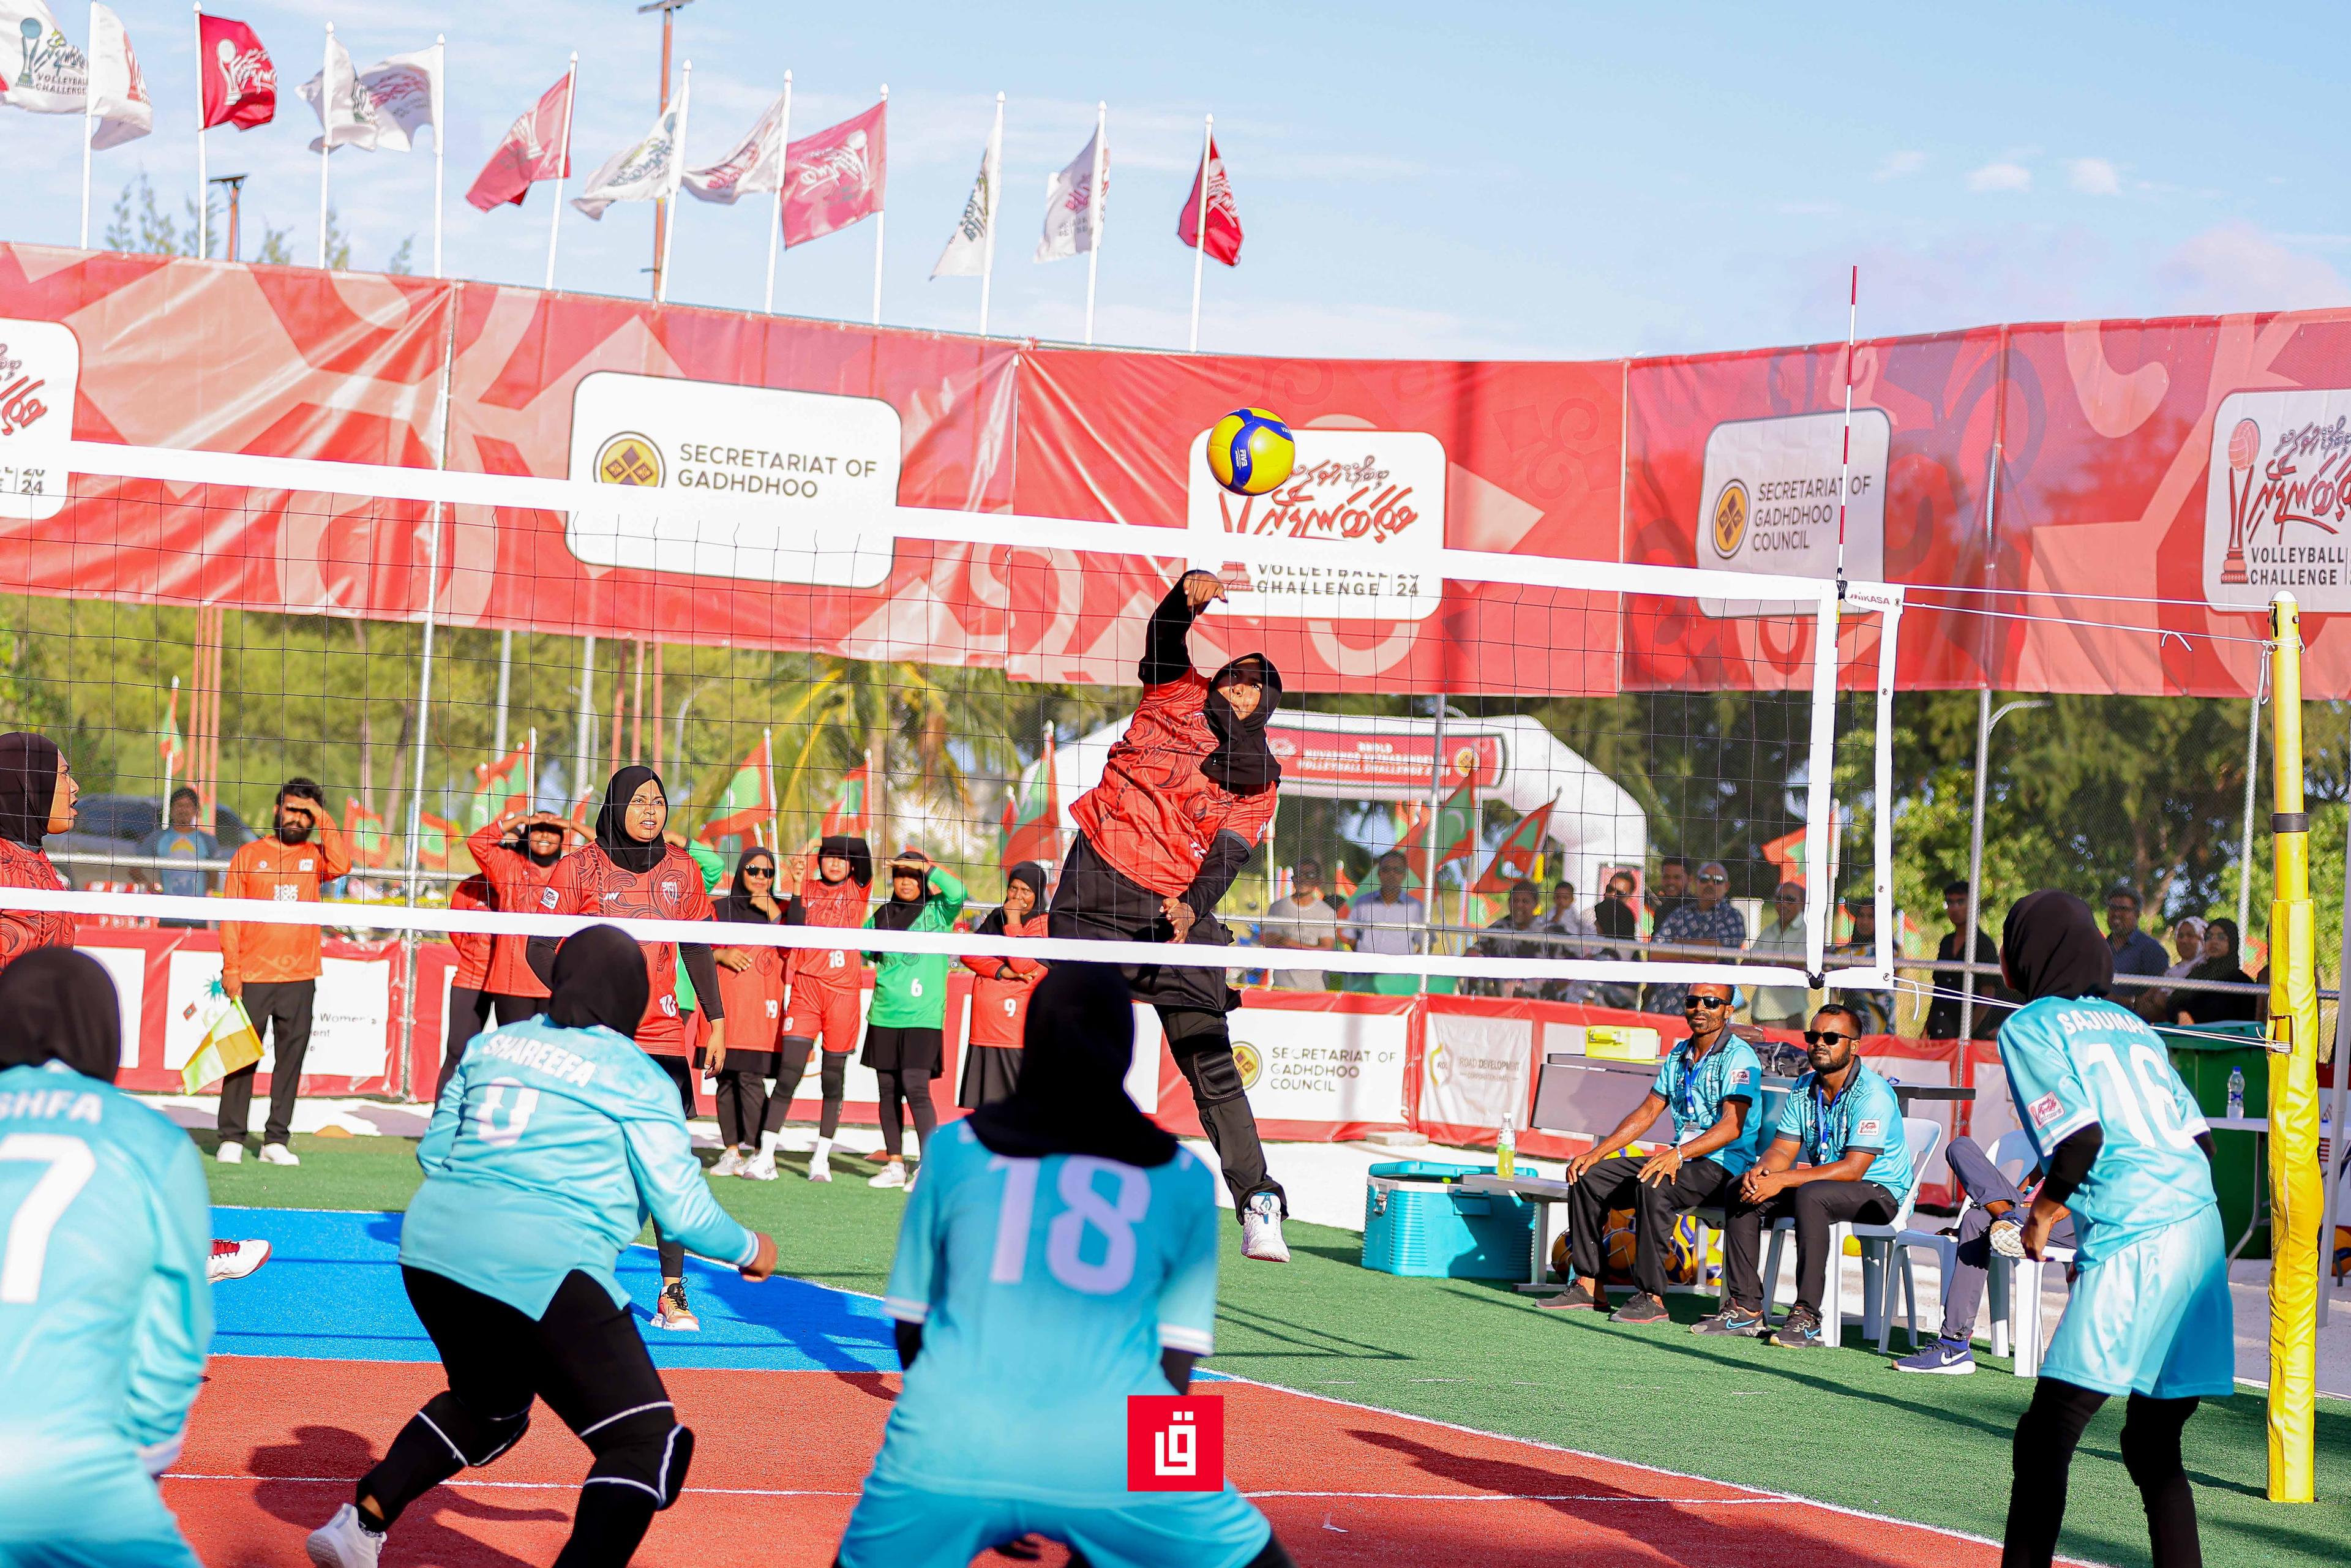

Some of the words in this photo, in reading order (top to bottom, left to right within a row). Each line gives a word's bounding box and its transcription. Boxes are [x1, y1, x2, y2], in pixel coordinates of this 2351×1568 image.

[680, 443, 838, 475] SECRETARIAT
[846, 459, 877, 477] OF
[21, 479, 43, 493] 24
[678, 469, 819, 498] GADHDHOO
[1851, 476, 1872, 495] OF
[1755, 505, 1833, 527] GADHDHOO
[1753, 530, 1810, 551] COUNCIL
[2251, 547, 2345, 563] VOLLEYBALL
[2250, 569, 2338, 585] CHALLENGE
[1257, 580, 1378, 596] CHALLENGE
[1397, 582, 1419, 596] 24
[828, 950, 846, 969] 18
[911, 978, 923, 997] 6
[765, 999, 778, 1019] 19
[1004, 998, 1016, 1018] 9
[482, 1033, 597, 1088] SHAREEFA
[1272, 1046, 1371, 1062] SECRETARIAT
[1378, 1051, 1397, 1063] OF
[1460, 1057, 1477, 1068] ROAD
[1270, 1063, 1360, 1078] GADHDHOO
[1270, 1078, 1337, 1092] COUNCIL
[2088, 1043, 2197, 1149] 16
[0, 1134, 97, 1304] 7
[986, 1153, 1153, 1296] 18
